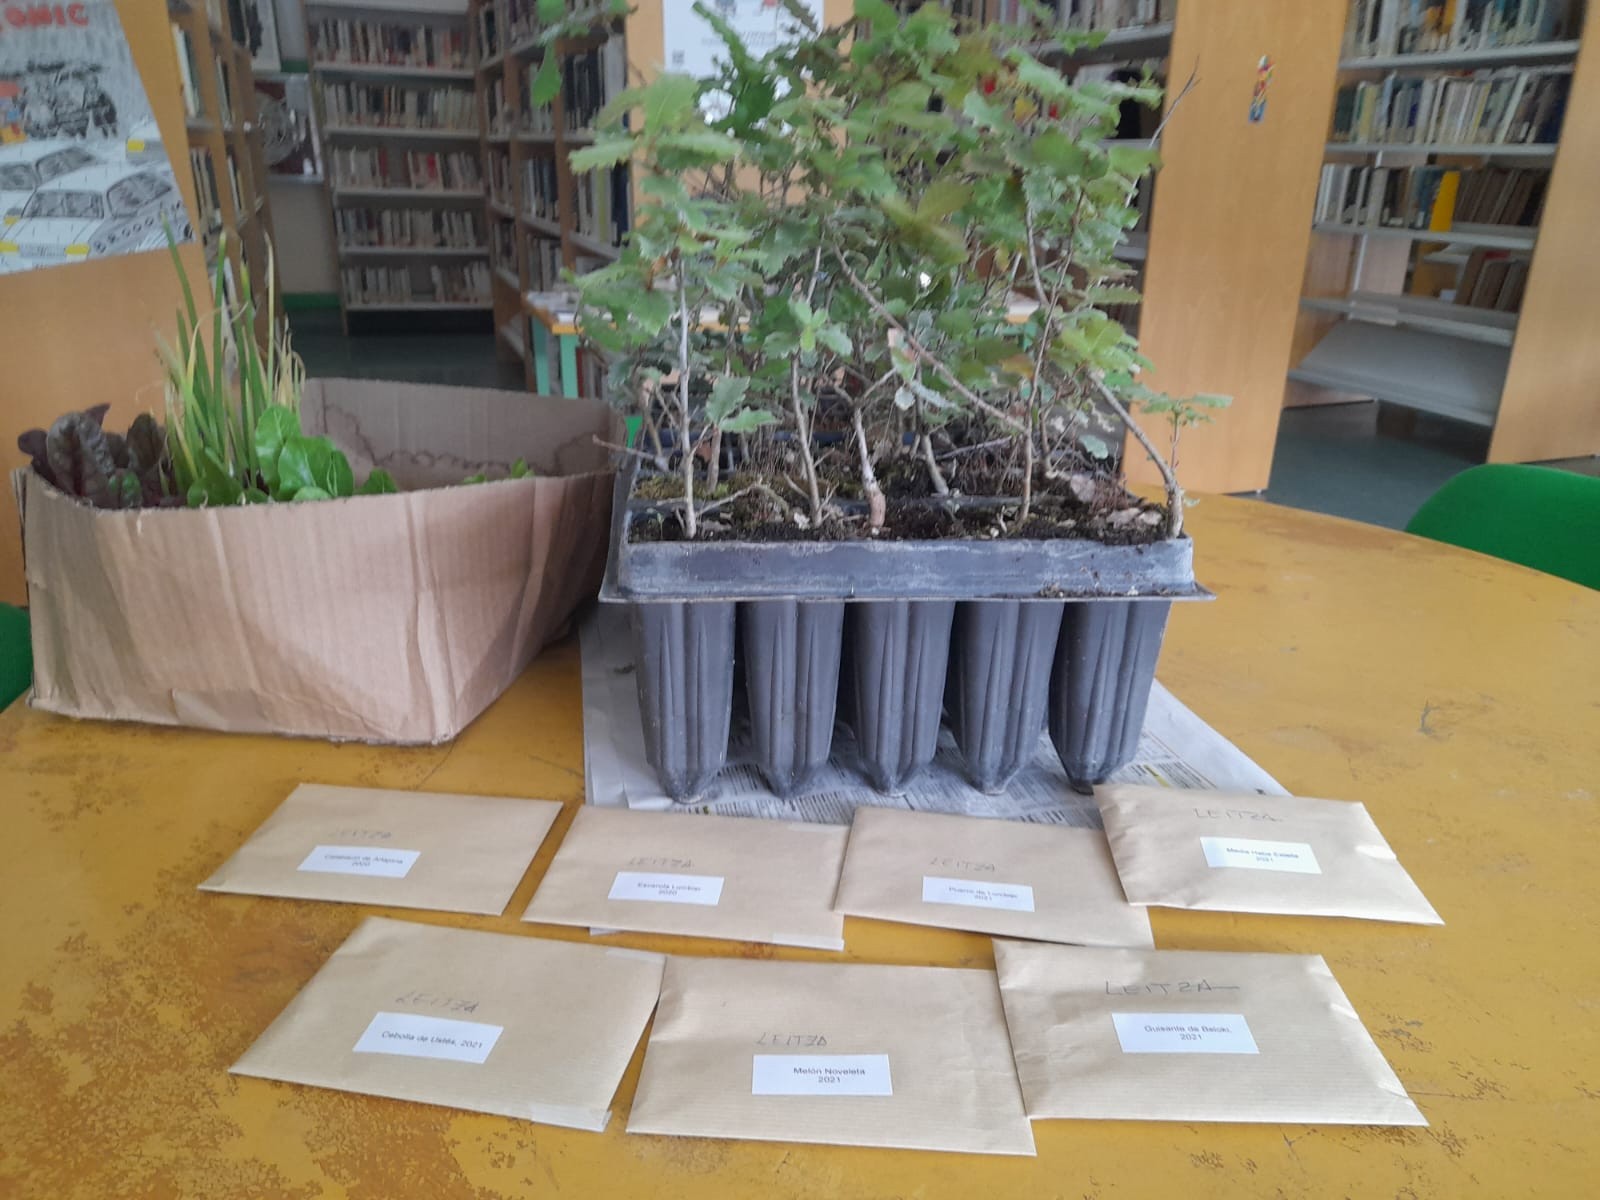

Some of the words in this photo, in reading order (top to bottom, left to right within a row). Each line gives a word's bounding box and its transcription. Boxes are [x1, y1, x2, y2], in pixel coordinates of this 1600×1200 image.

[0, 3, 89, 31] OMIC
[1179, 1033, 1203, 1042] 2021
[793, 1066, 822, 1076] Melón
[818, 1075, 842, 1084] 2021
